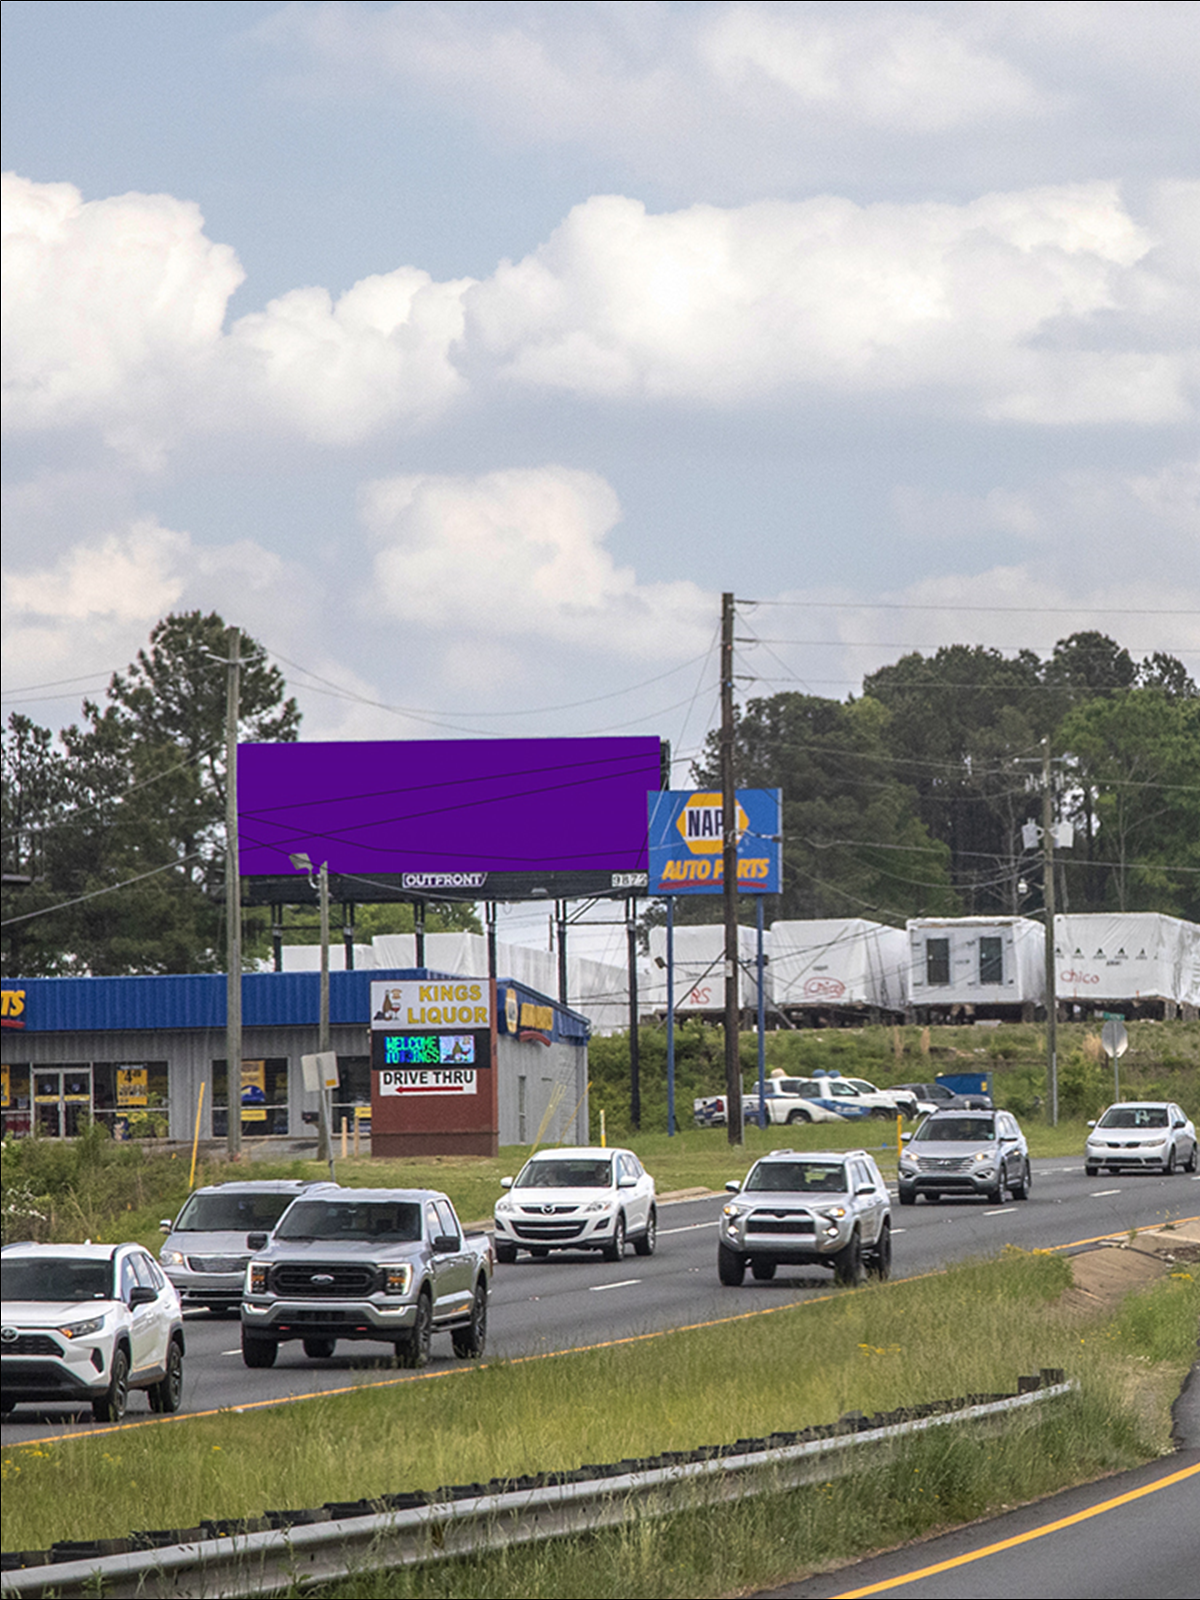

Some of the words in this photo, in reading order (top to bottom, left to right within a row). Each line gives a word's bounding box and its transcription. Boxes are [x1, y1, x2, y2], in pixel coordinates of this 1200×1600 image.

[661, 859, 712, 880] AUTO
[713, 857, 769, 878] PRTS
[405, 873, 482, 886] OUTFRONT
[419, 985, 482, 1001] KINGS
[1, 990, 26, 1017] TS
[407, 1006, 488, 1025] LIQUOR
[384, 1036, 437, 1051] WELCOME
[383, 1072, 428, 1085] DRIVE
[432, 1071, 475, 1085] THRU
